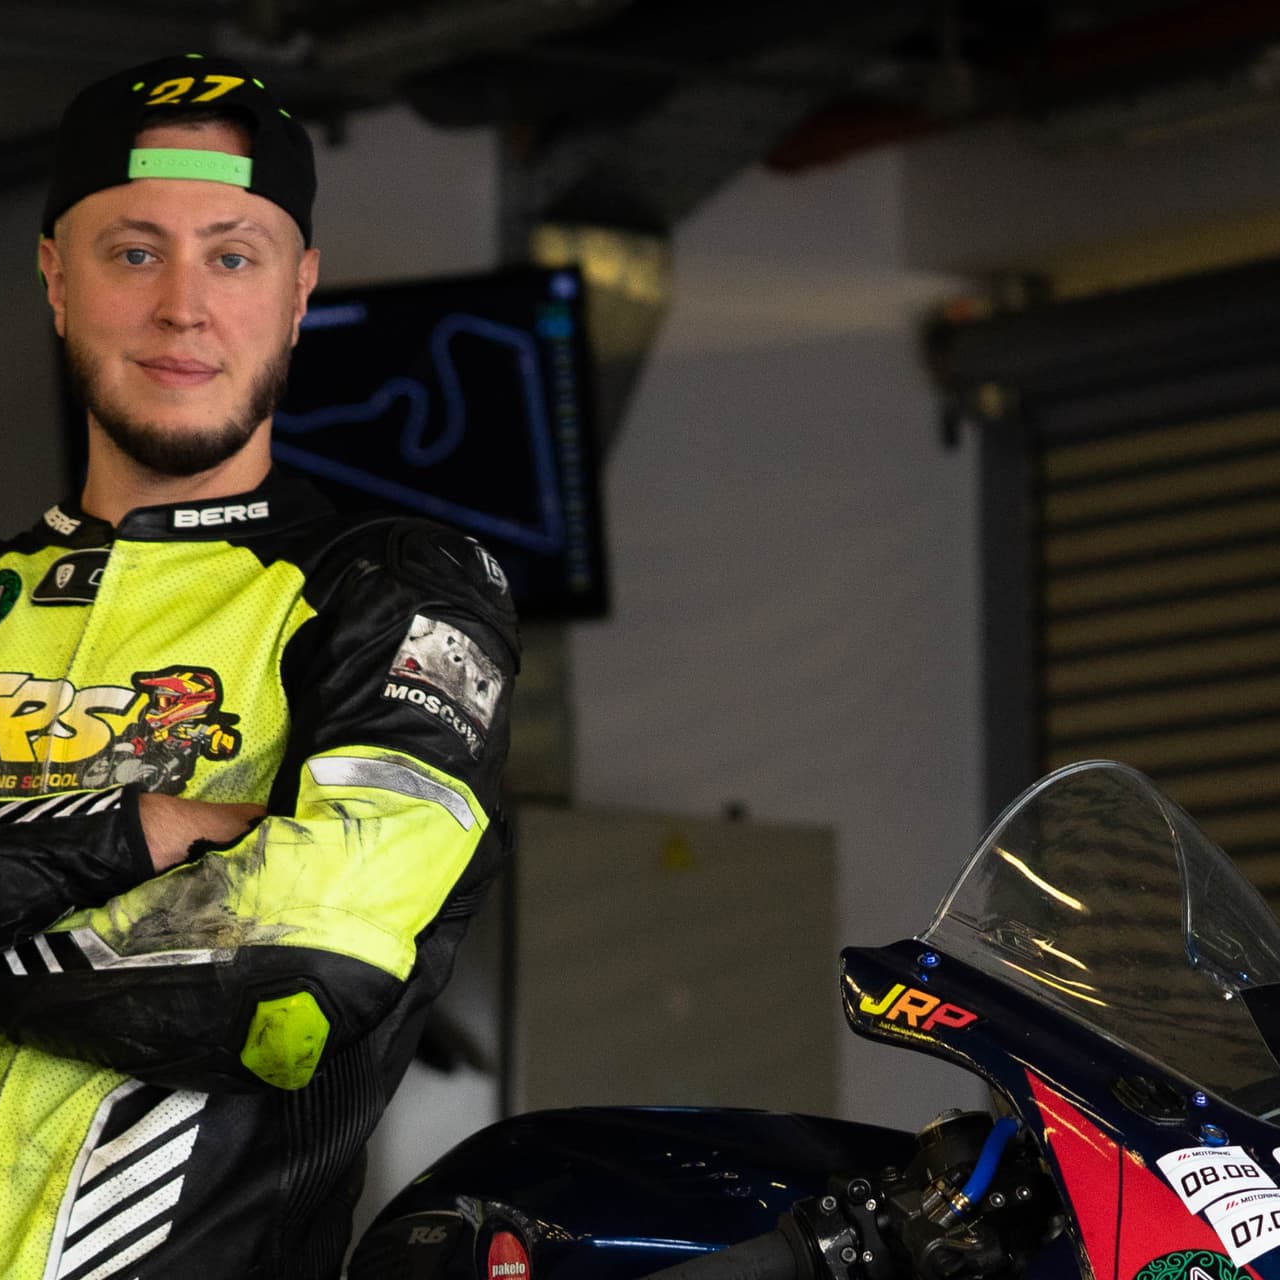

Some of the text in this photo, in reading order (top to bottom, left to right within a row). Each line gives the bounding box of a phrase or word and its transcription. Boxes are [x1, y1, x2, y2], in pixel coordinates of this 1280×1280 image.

[144, 75, 245, 105] 27
[174, 502, 269, 528] BERG
[21, 773, 80, 789] SCOOL
[860, 984, 978, 1031] JRP
[1181, 1164, 1260, 1198] 08.08
[408, 1225, 448, 1245] R6
[492, 1261, 526, 1277] pakelo
